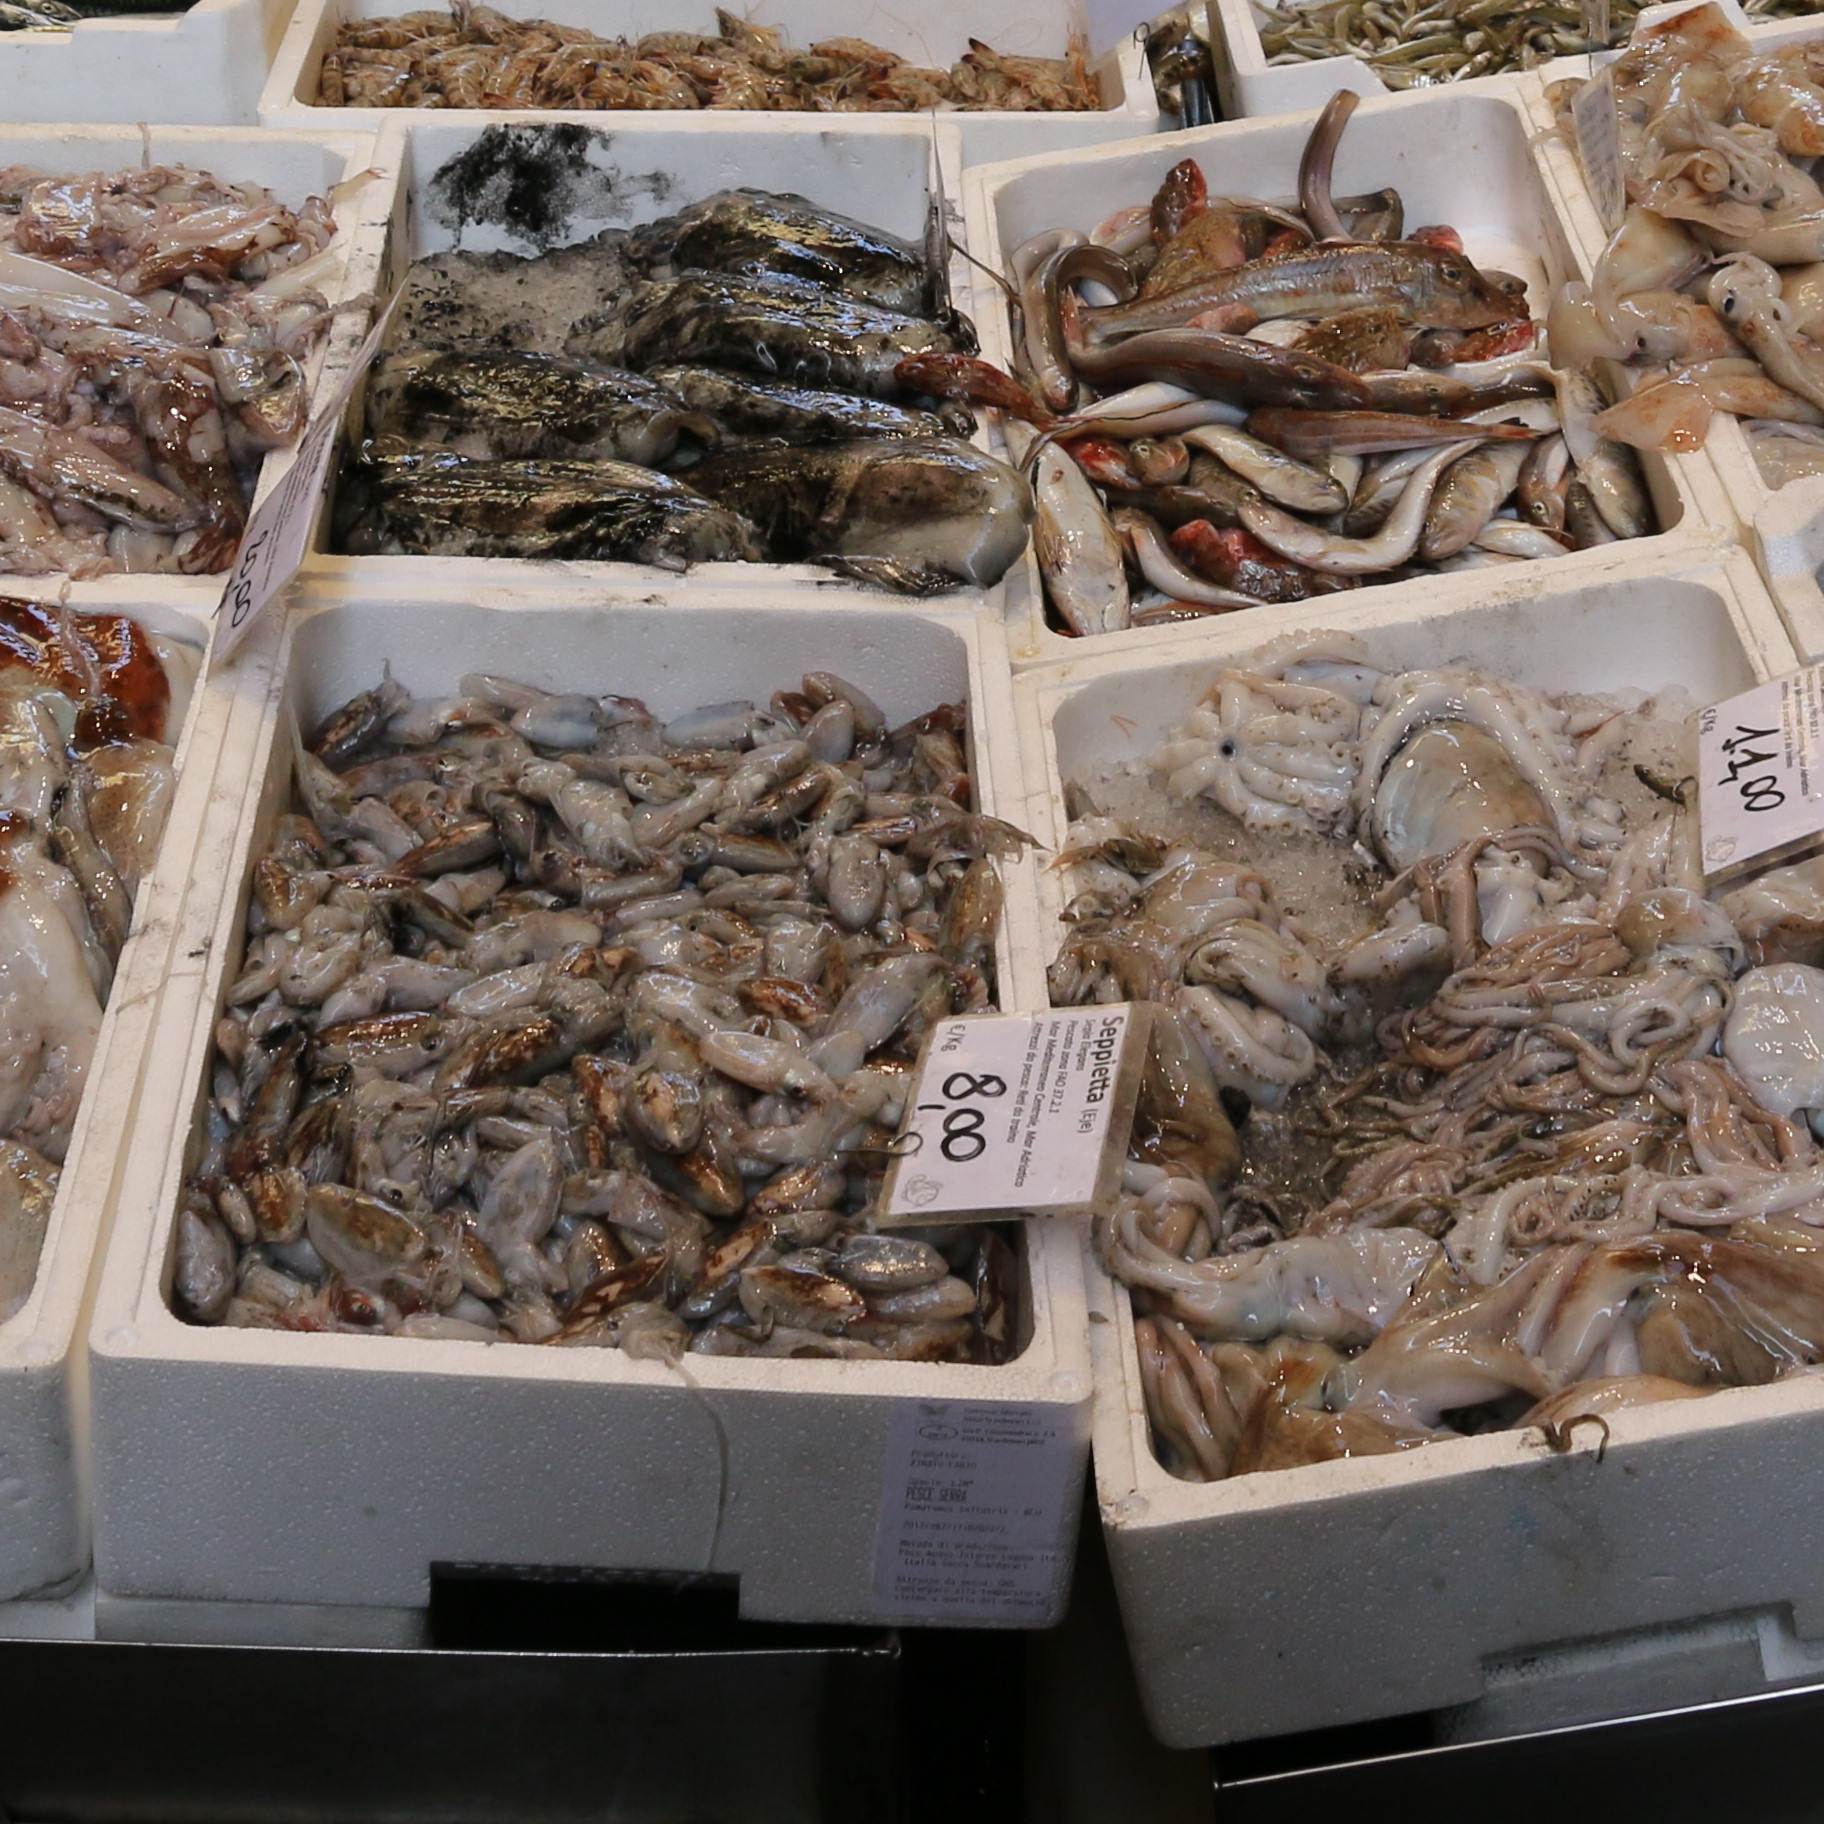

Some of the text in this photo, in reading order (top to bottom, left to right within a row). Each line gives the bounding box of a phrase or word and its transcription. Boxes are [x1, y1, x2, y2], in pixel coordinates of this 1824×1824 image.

[1718, 725, 1786, 813] 11,00
[939, 1023, 967, 1052] €/Kg
[1047, 1020, 1061, 1038] Mar
[1034, 1038, 1057, 1092] Mediterraneo
[1048, 1019, 1078, 1113] Pescato zona FAO 37.2.1
[1075, 1015, 1124, 1134] Seppietta (Eje)
[918, 1072, 1008, 1163] 8,00
[1022, 1129, 1036, 1147] Mar
[1013, 1148, 1032, 1188] Adriatico
[905, 1485, 967, 1503] PESCE SERRA
